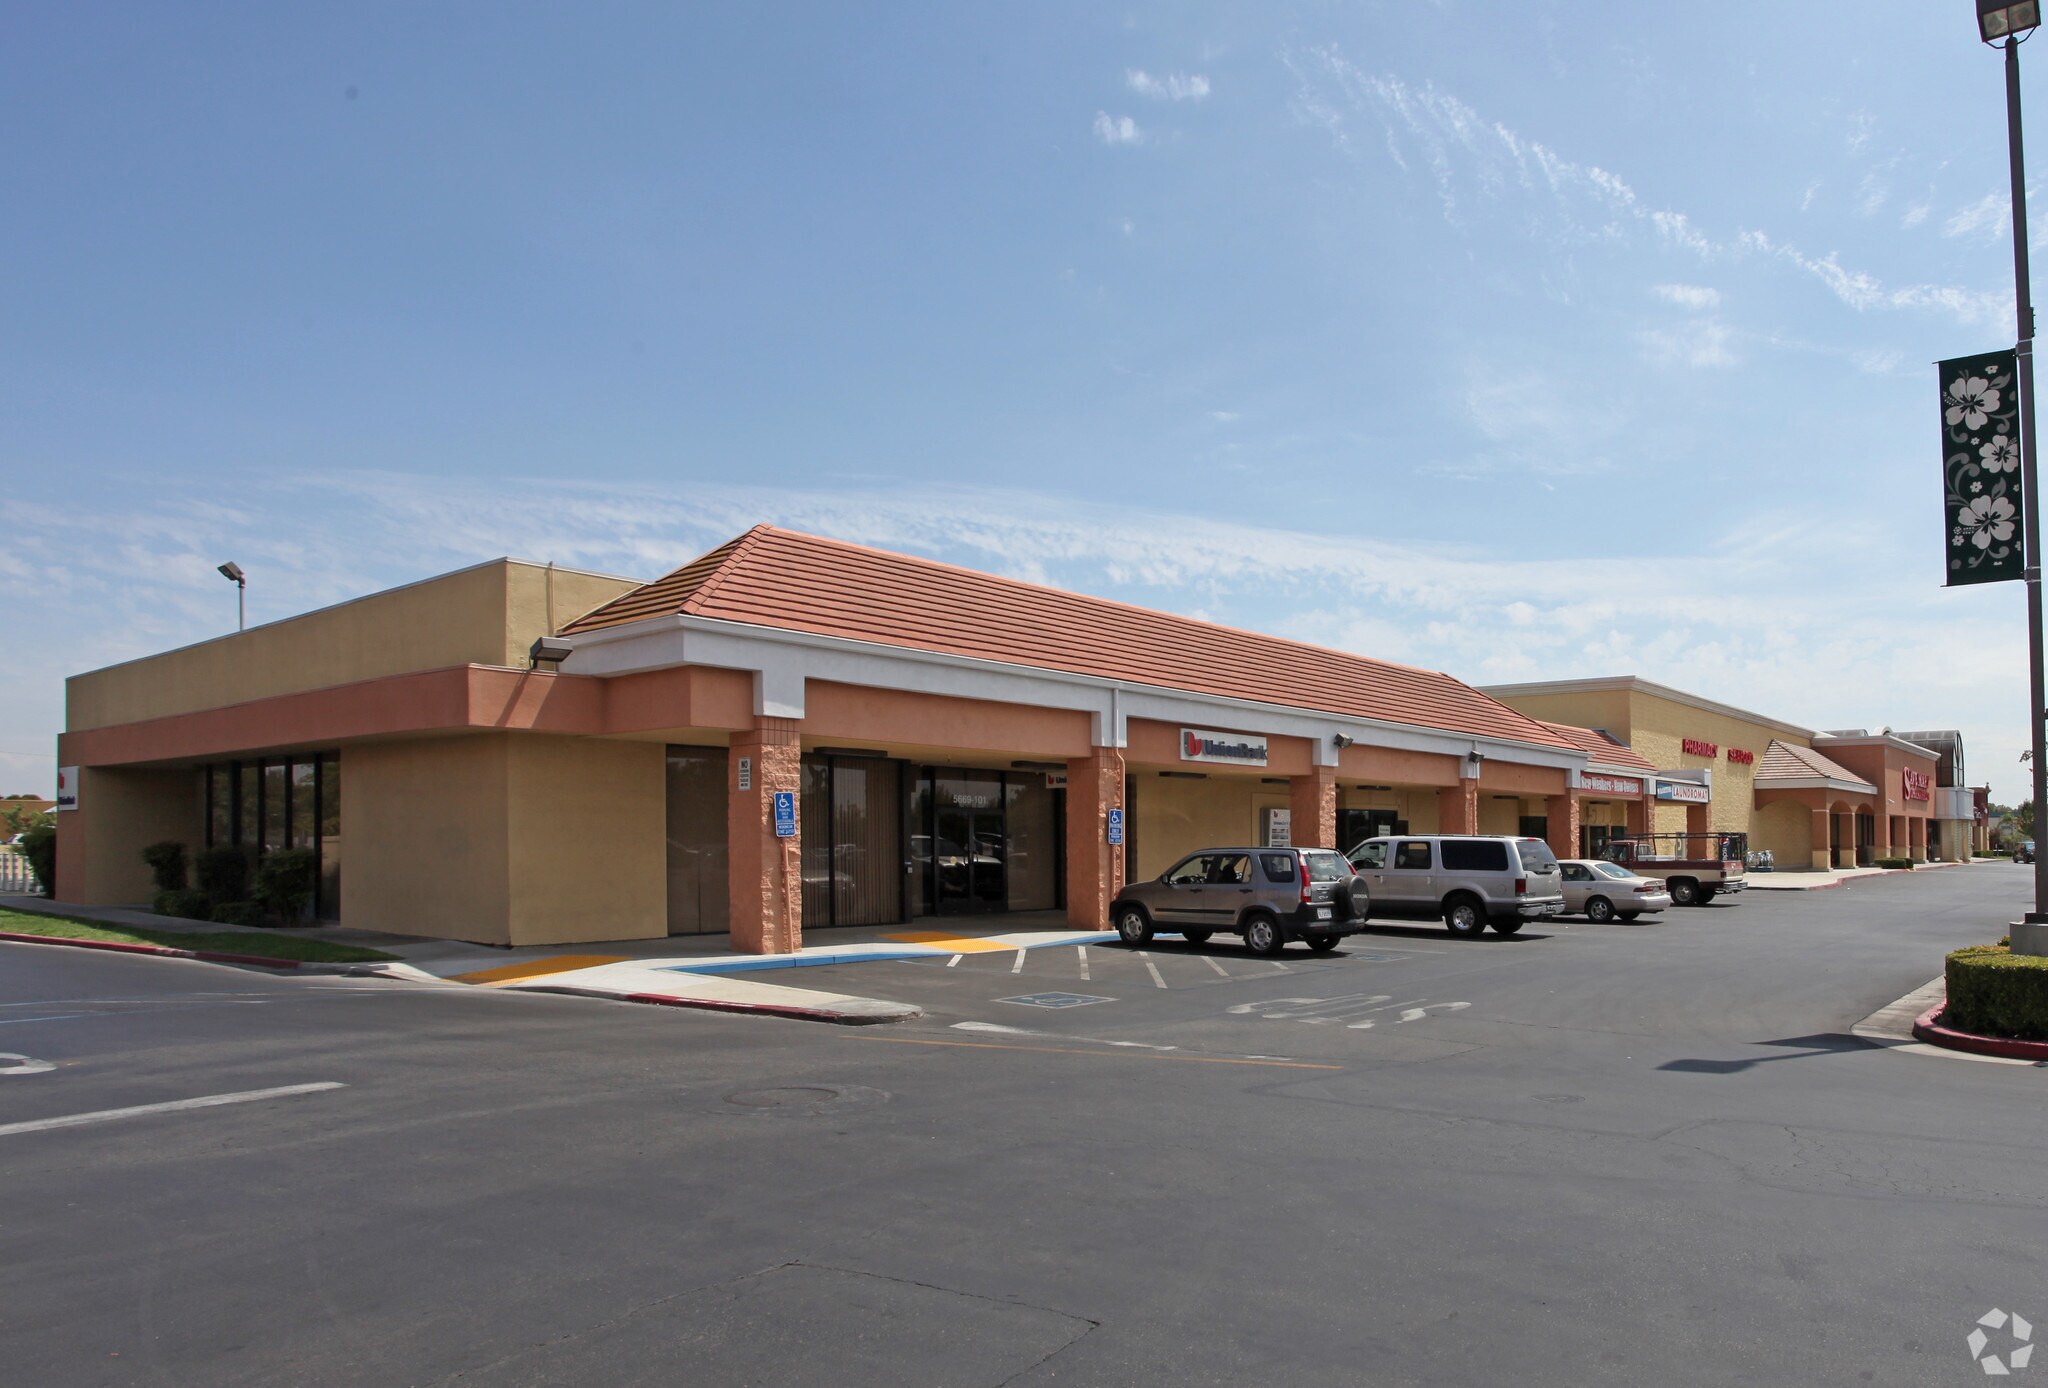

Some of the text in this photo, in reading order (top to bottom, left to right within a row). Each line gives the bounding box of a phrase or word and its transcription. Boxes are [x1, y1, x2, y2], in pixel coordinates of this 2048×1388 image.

[1203, 739, 1267, 760] UnionBank
[1682, 739, 1718, 759] PHARMACY
[741, 760, 749, 768] NO
[953, 795, 986, 804] 5669-101
[1673, 785, 1708, 800] LAUNDROMAT
